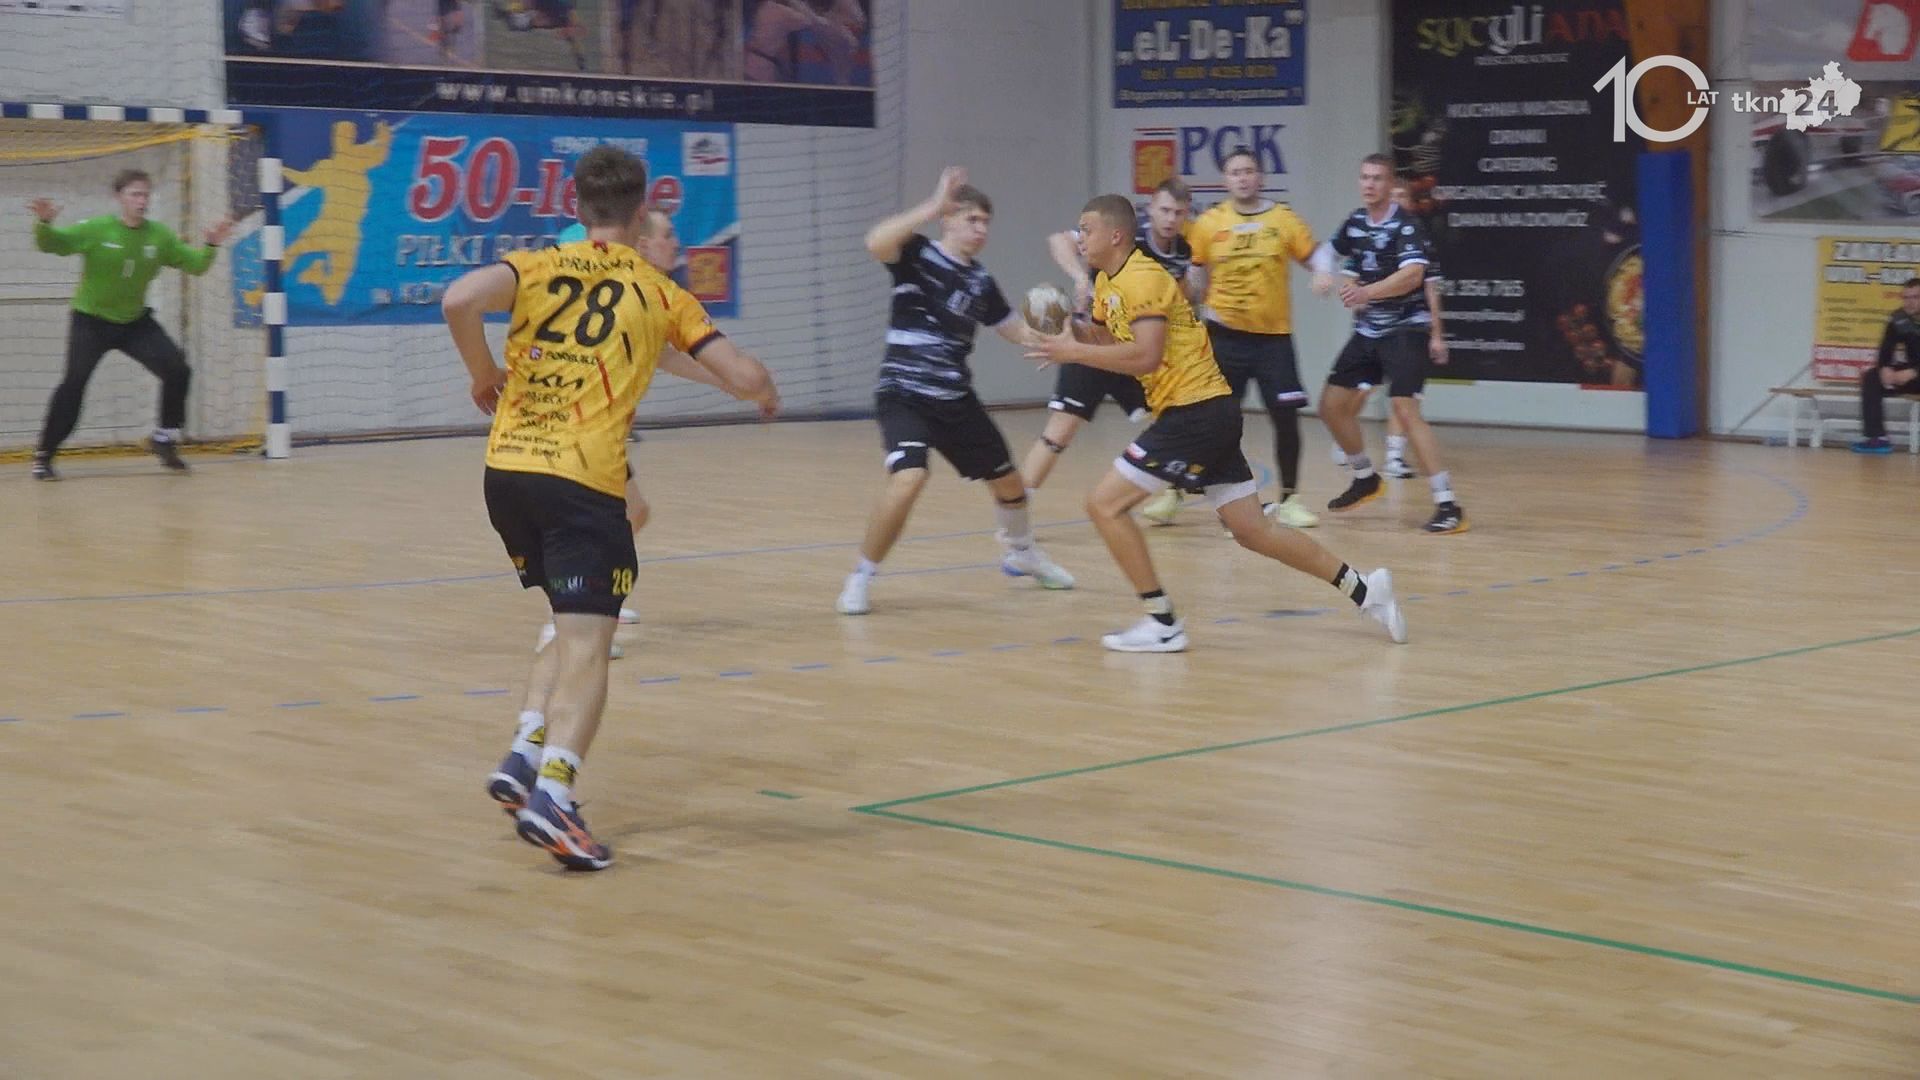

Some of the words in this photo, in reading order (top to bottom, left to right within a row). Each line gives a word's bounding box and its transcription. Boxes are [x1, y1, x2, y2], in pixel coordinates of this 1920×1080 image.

[435, 81, 715, 114] www.umkonskie.pl
[1477, 156, 1558, 173] CATERING
[533, 275, 625, 347] 28
[611, 567, 633, 596] 28
